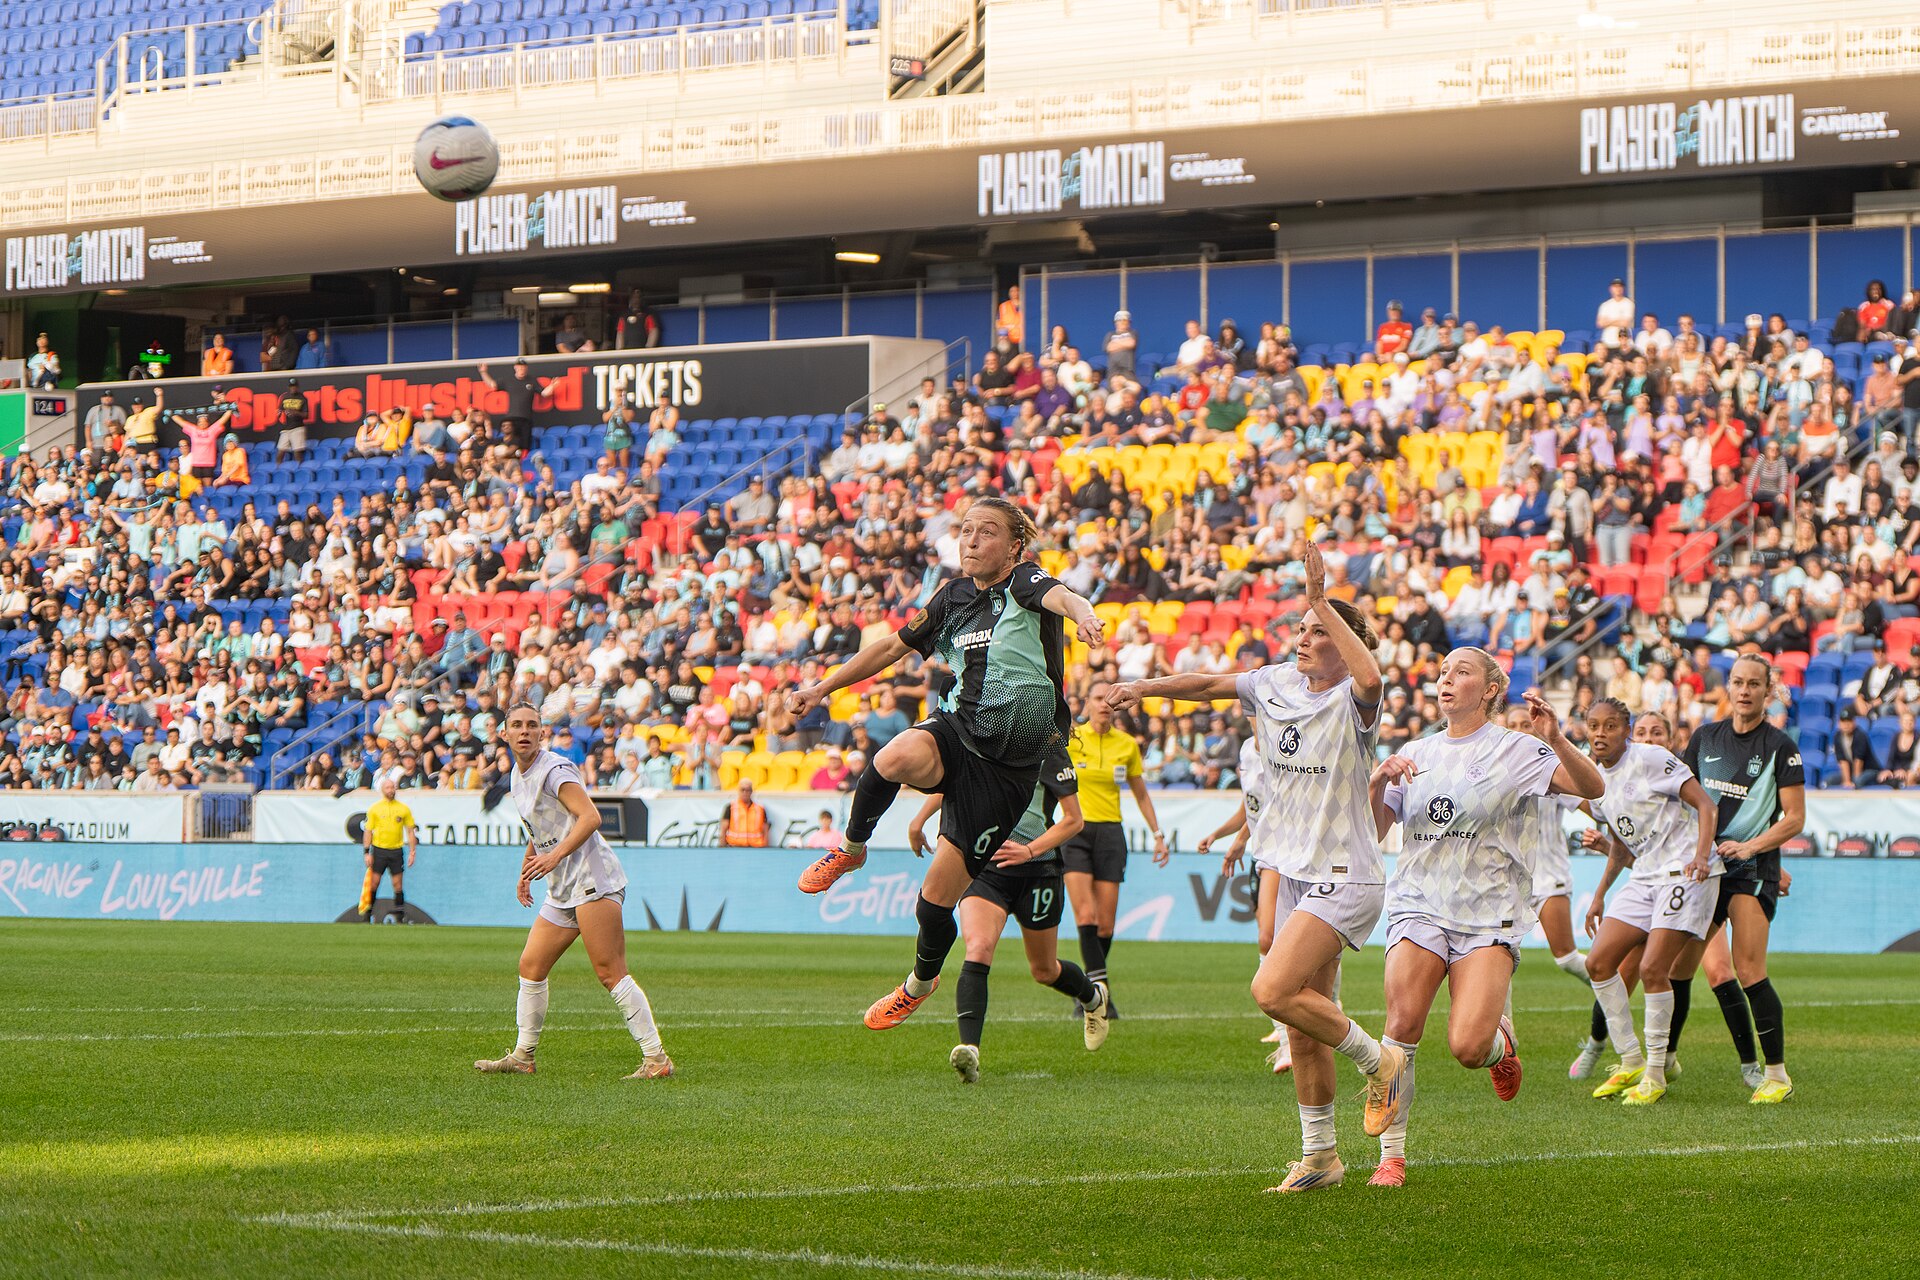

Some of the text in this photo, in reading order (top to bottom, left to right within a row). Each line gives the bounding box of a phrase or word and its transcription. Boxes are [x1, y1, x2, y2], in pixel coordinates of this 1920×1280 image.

[891, 58, 911, 75] 225
[1580, 102, 1677, 175] PLAYER
[1697, 94, 1795, 167] MATCH
[978, 149, 1062, 216] PLAYER
[1080, 141, 1165, 209] MATCH
[456, 193, 528, 255] PLAYER
[543, 185, 617, 249] MATCH
[6, 233, 68, 291] PLAYER
[81, 226, 145, 285] MATCH
[35, 400, 54, 413] 124
[366, 366, 583, 418] Illustrad
[593, 360, 702, 410] TICKETS
[1056, 767, 1077, 782] ally
[1787, 753, 1803, 767] all
[973, 825, 999, 854] 6
[0, 857, 270, 921] RACING LOUISVILLE
[1031, 888, 1054, 914] 19
[1188, 872, 1258, 923] VS
[1669, 885, 1685, 911] 8
